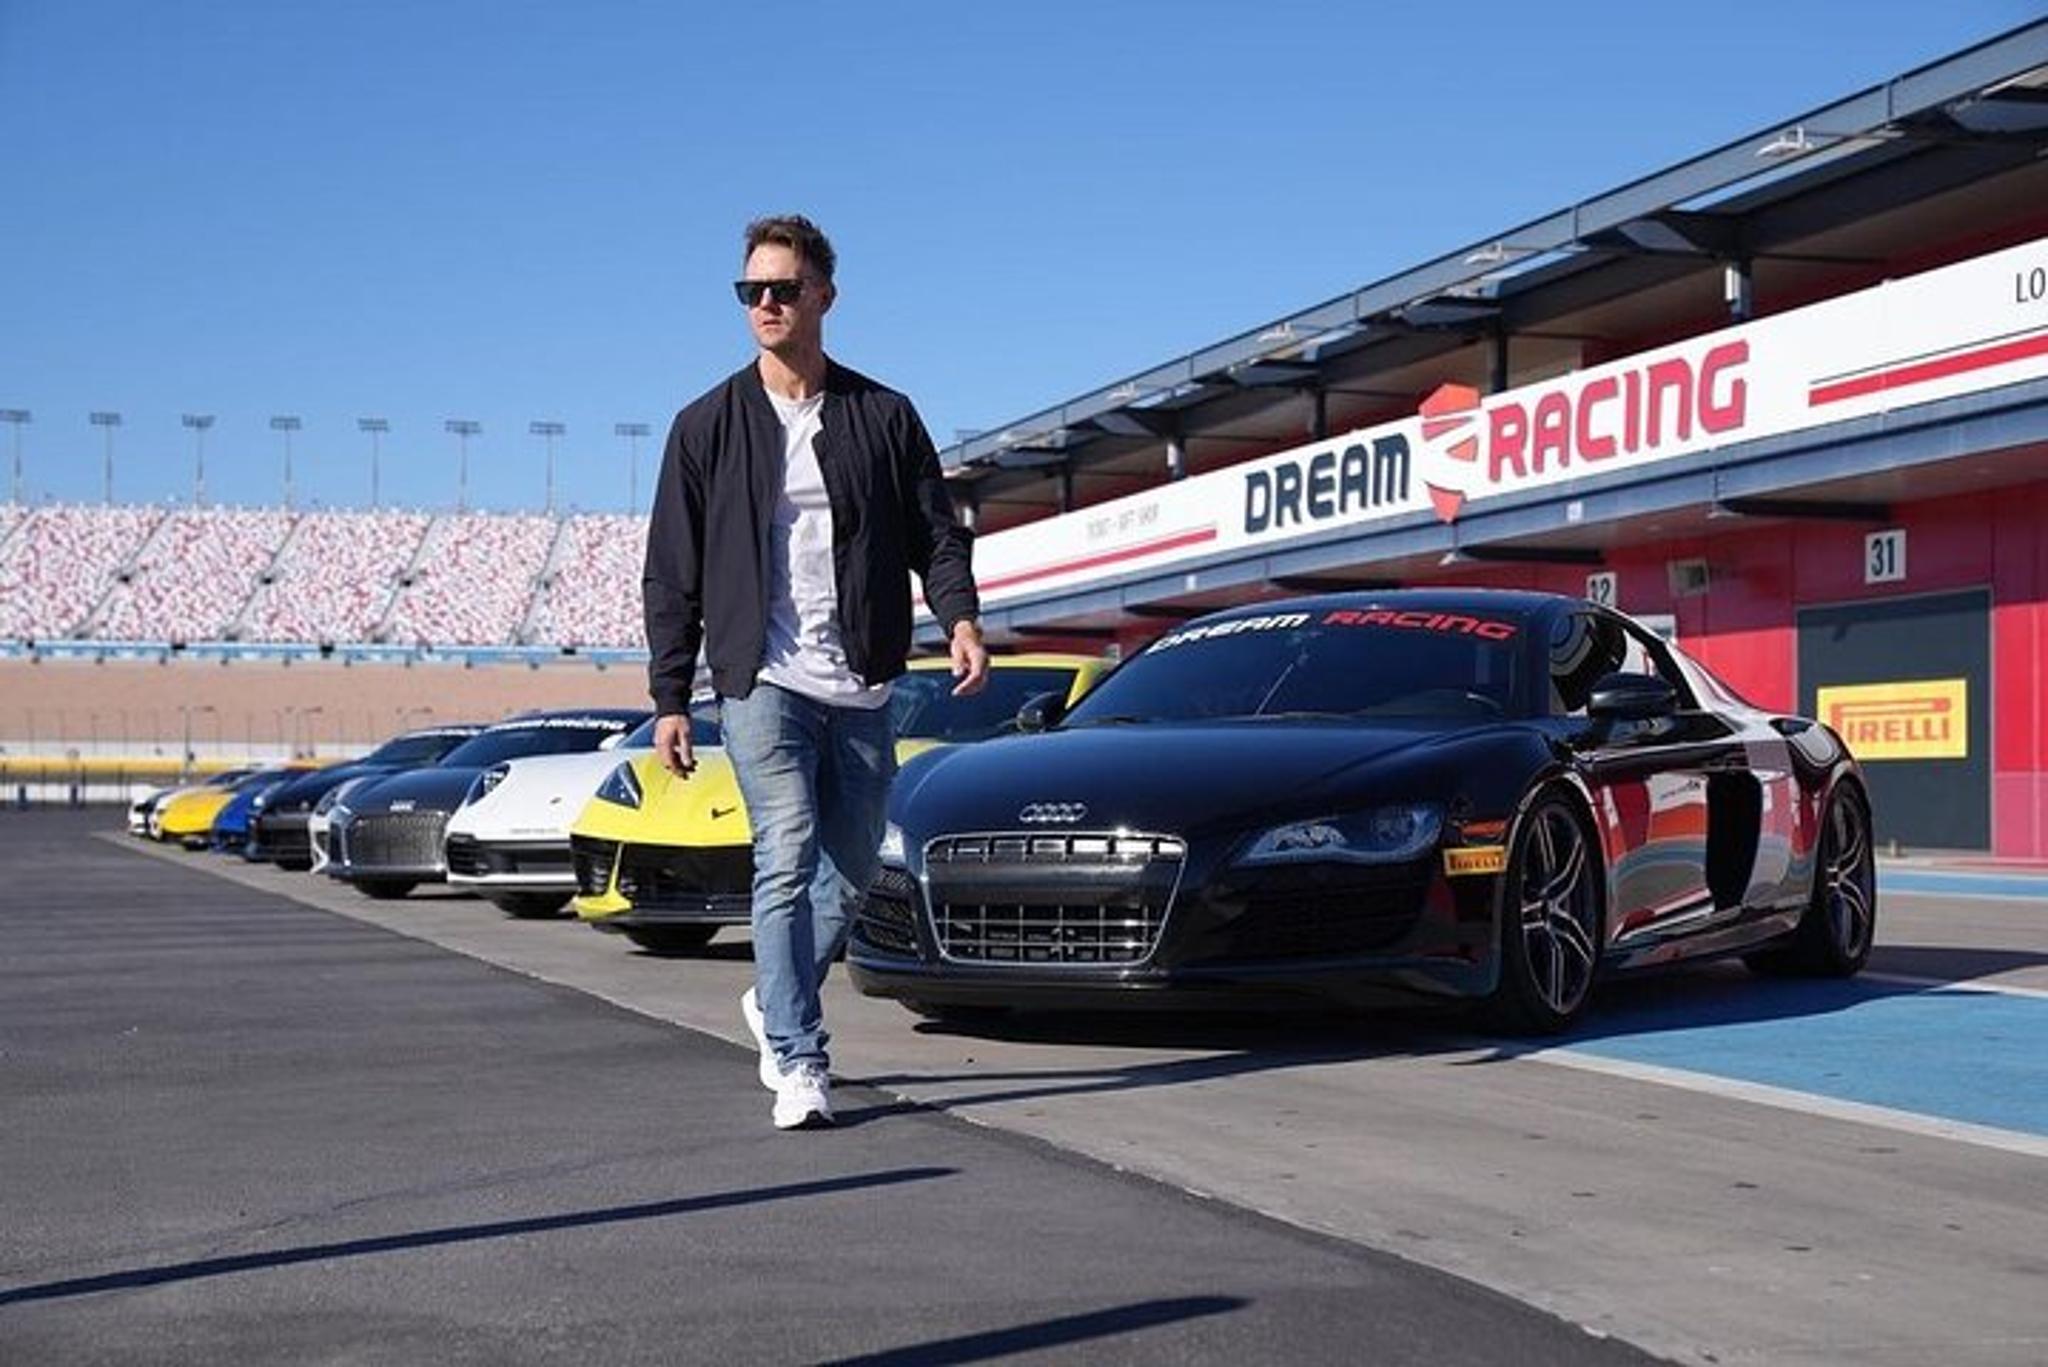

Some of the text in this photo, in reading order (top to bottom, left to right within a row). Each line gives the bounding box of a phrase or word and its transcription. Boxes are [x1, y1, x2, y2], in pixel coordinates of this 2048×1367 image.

[1244, 340, 1750, 533] DREAM RACING
[1871, 536, 1895, 577] 31
[1144, 610, 1518, 656] DREAM RACING
[1830, 697, 1952, 742] PIRELLI
